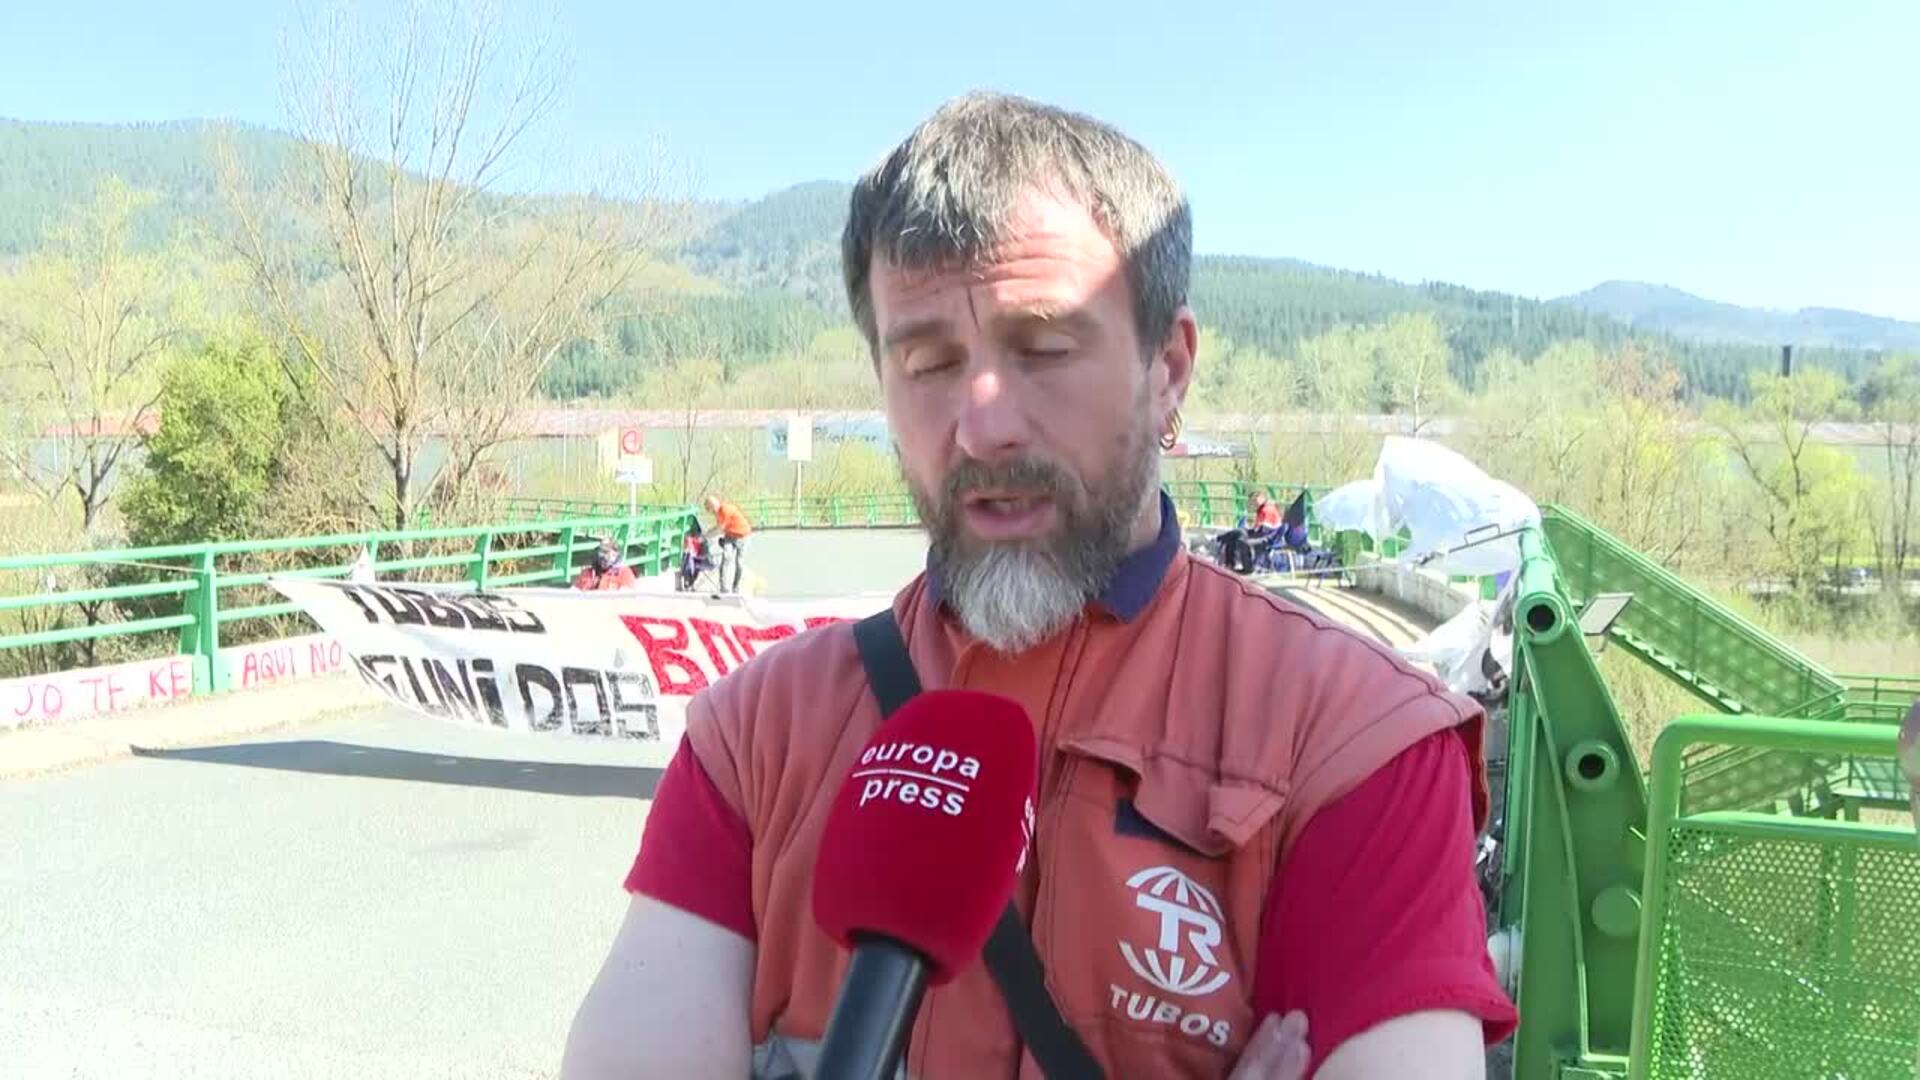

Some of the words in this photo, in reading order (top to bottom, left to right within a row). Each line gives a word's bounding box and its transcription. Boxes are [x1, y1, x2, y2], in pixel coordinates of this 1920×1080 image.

[342, 585, 547, 634] TUBOS
[149, 660, 190, 699] KE
[242, 647, 297, 688] AQUI
[309, 639, 342, 674] NO
[860, 741, 982, 780] europa
[859, 776, 966, 817] press
[1136, 892, 1222, 967] TR
[1109, 983, 1231, 1047] TUBOS
